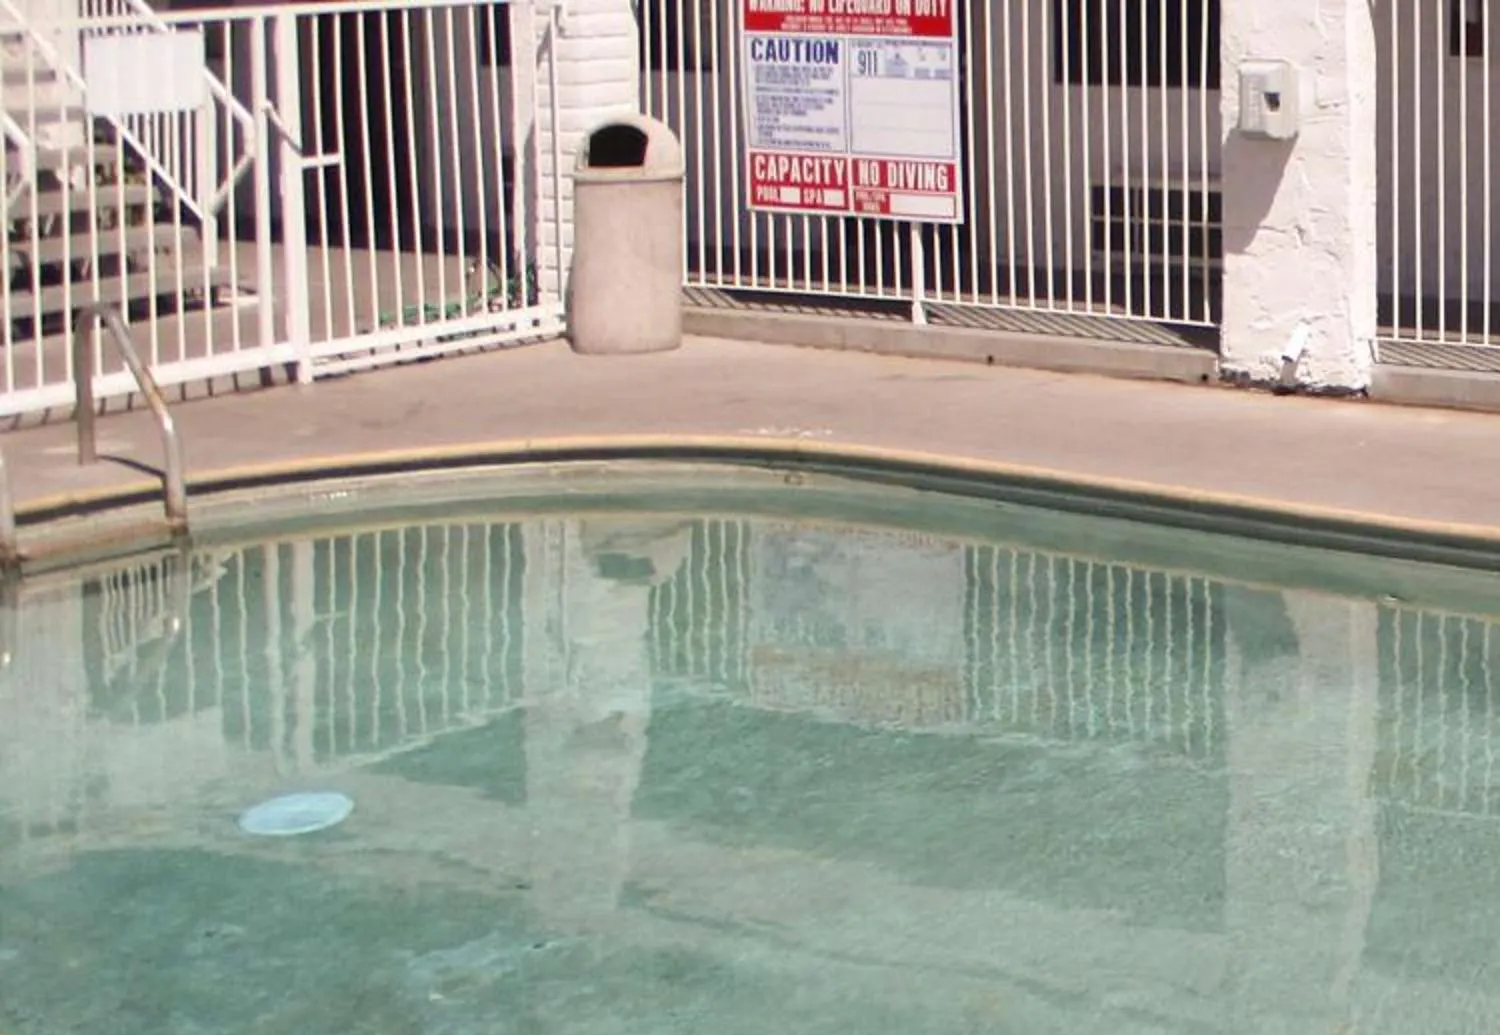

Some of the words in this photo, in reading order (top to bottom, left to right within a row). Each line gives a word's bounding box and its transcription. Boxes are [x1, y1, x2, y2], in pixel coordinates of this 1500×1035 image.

[809, 0, 825, 13] NO
[829, 0, 891, 14] LIFEGUARD
[895, 0, 912, 15] ON
[914, 0, 948, 17] DUTY
[751, 38, 839, 64] CAUTION
[857, 51, 878, 77] 911
[754, 155, 845, 187] CAPACITY
[859, 162, 879, 187] NO
[887, 164, 949, 190] DIVING
[756, 186, 780, 202] POOL
[804, 187, 822, 205] SPA
